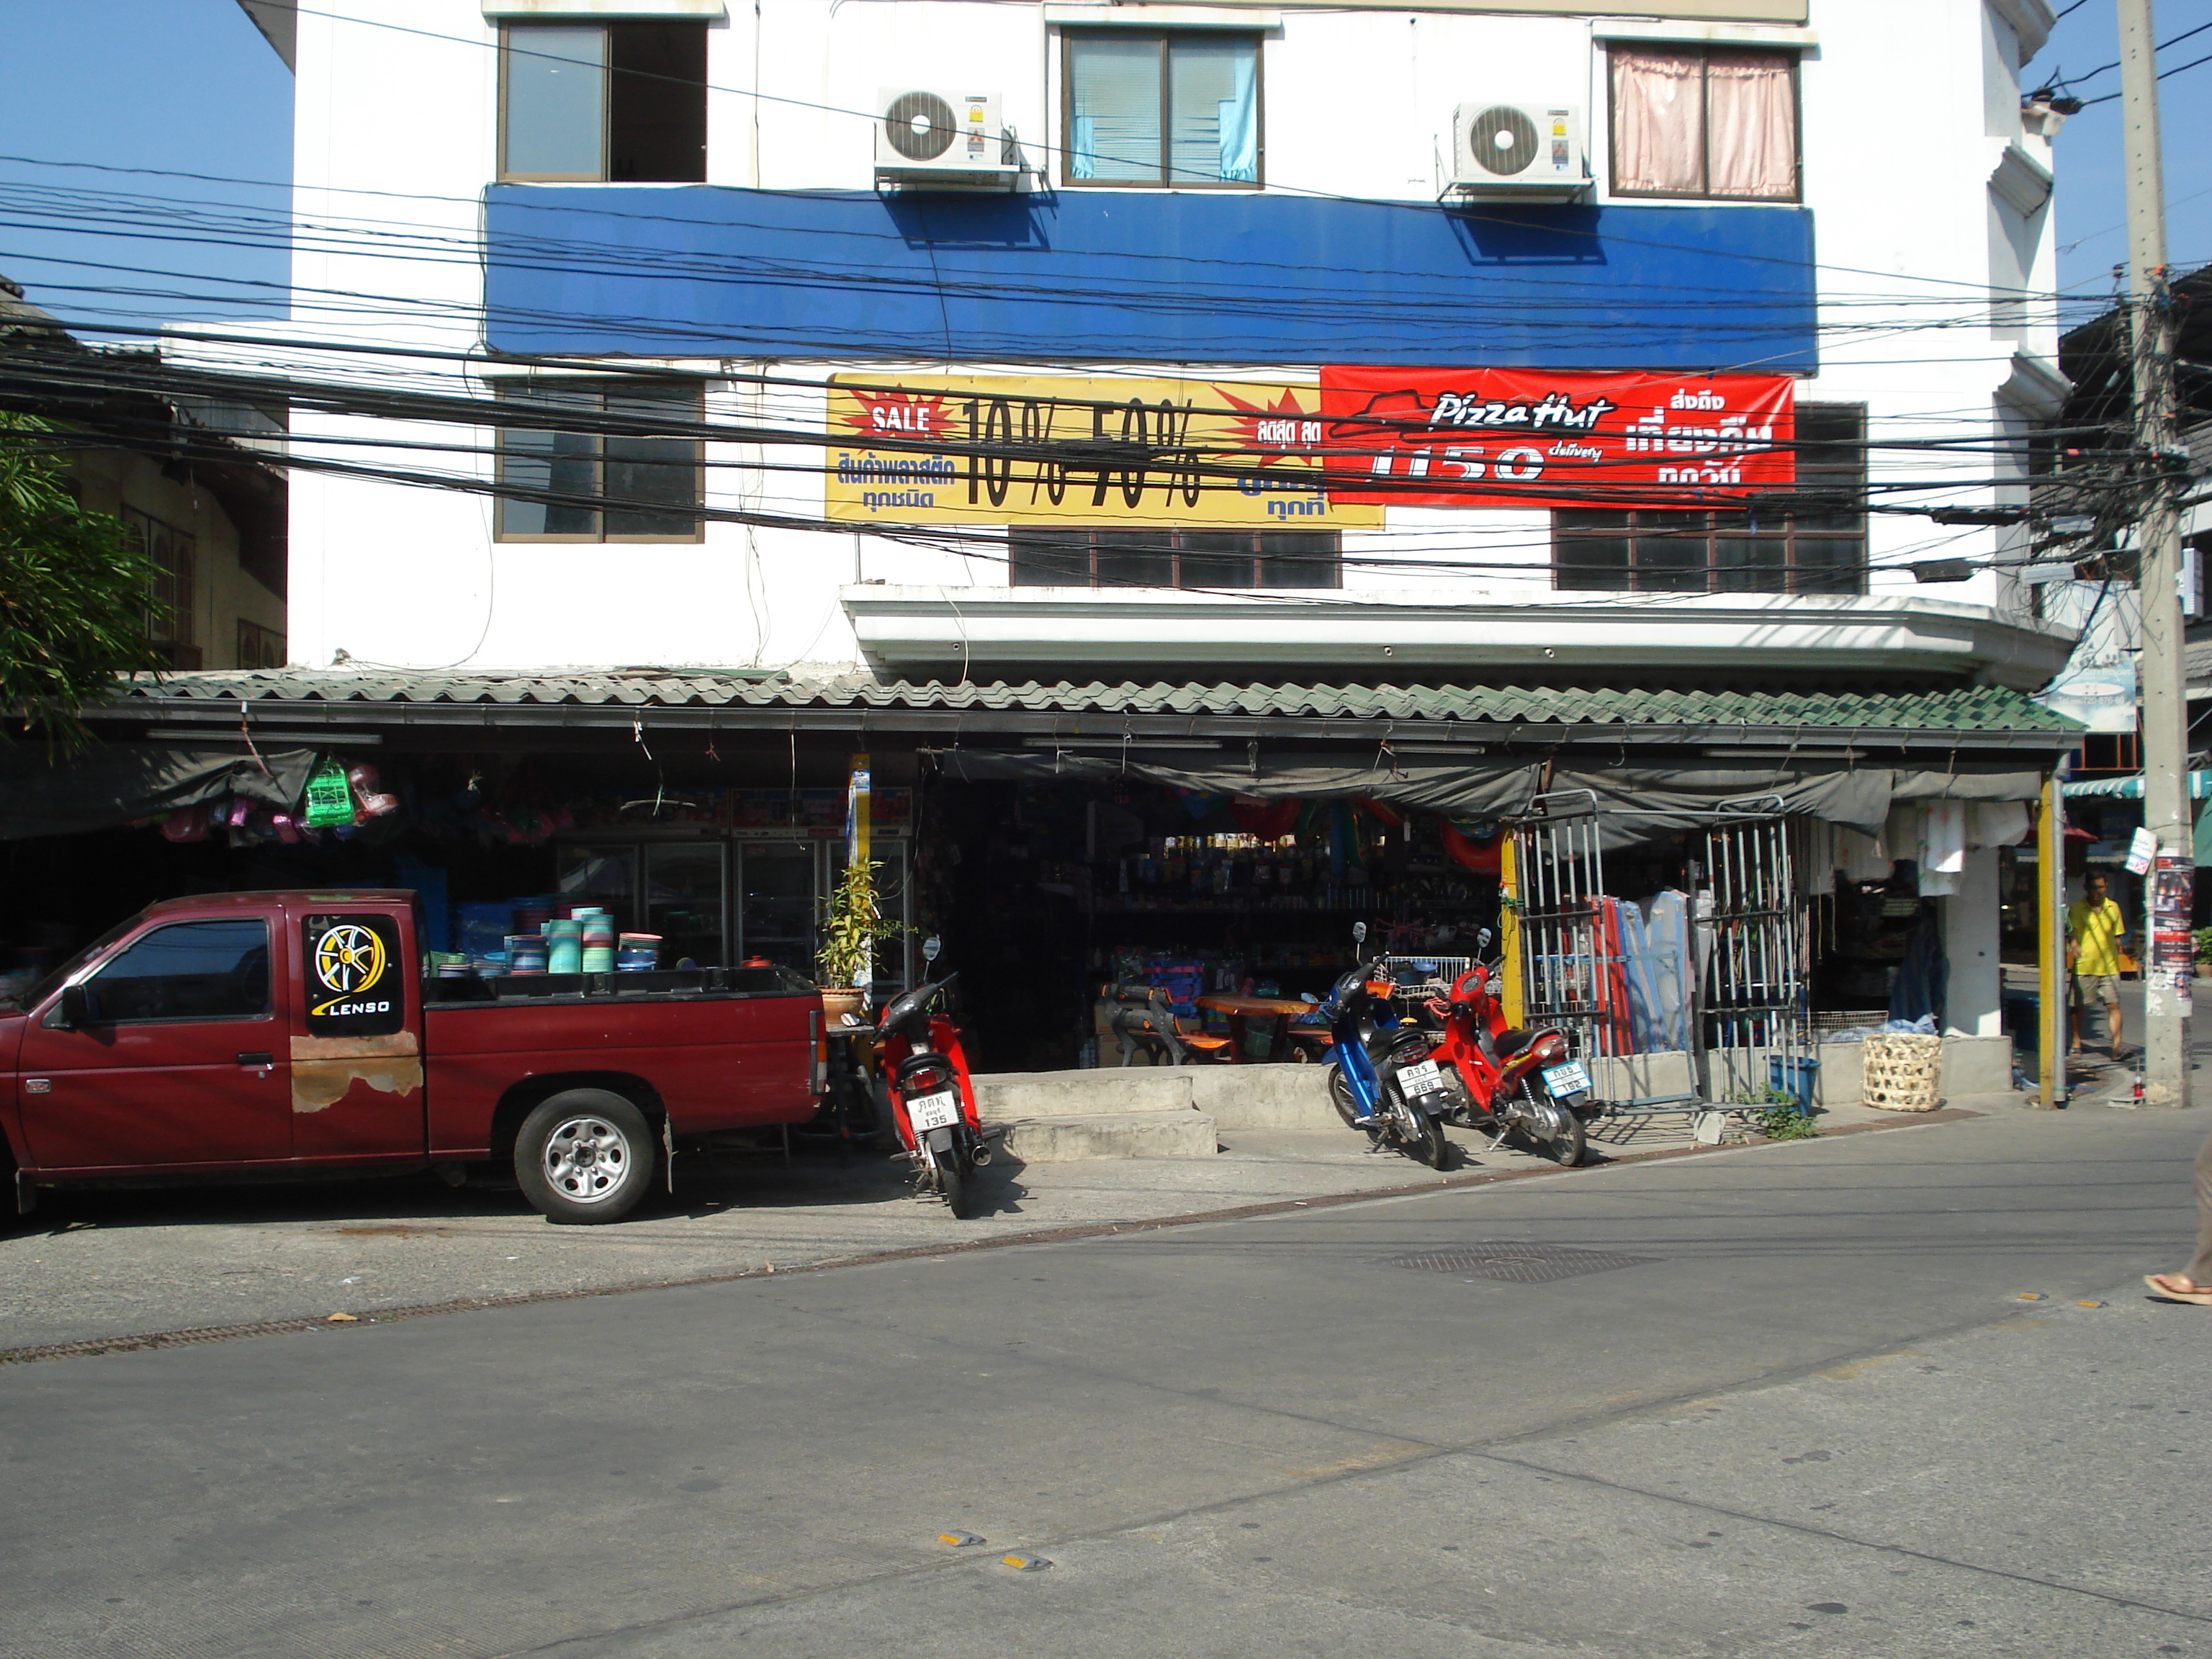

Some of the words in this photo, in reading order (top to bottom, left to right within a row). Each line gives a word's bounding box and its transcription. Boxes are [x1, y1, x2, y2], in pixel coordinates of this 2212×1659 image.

[1670, 387, 1726, 410] ส่งถึง
[872, 406, 930, 432] SALE
[1426, 392, 1529, 432] Pizza
[1532, 392, 1615, 429] Hut
[963, 397, 1066, 507] 10%
[1371, 445, 1545, 481] 1150
[1658, 459, 1741, 484] ทกวัน
[863, 489, 934, 513] ทุกชนิด
[1267, 491, 1325, 520] ทุกที่
[329, 1001, 390, 1016] LENSO
[1413, 1082, 1434, 1094] 669
[925, 1114, 948, 1128] 135
